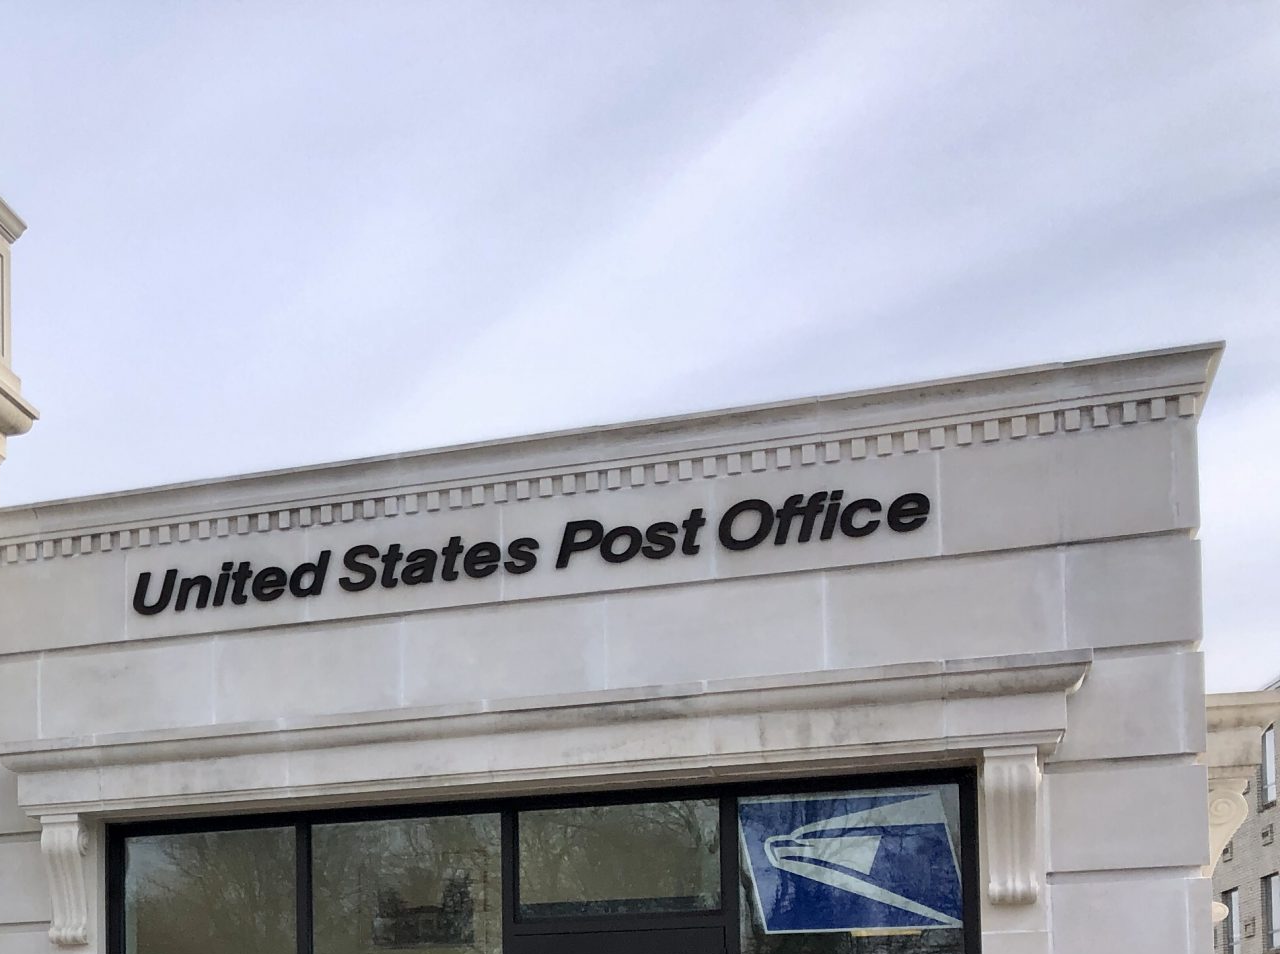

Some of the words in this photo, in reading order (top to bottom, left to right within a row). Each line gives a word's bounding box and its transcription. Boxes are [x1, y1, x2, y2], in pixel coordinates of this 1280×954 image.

[132, 550, 331, 615] United
[338, 533, 539, 592] States
[555, 508, 706, 570] Post
[717, 489, 931, 551] Office
